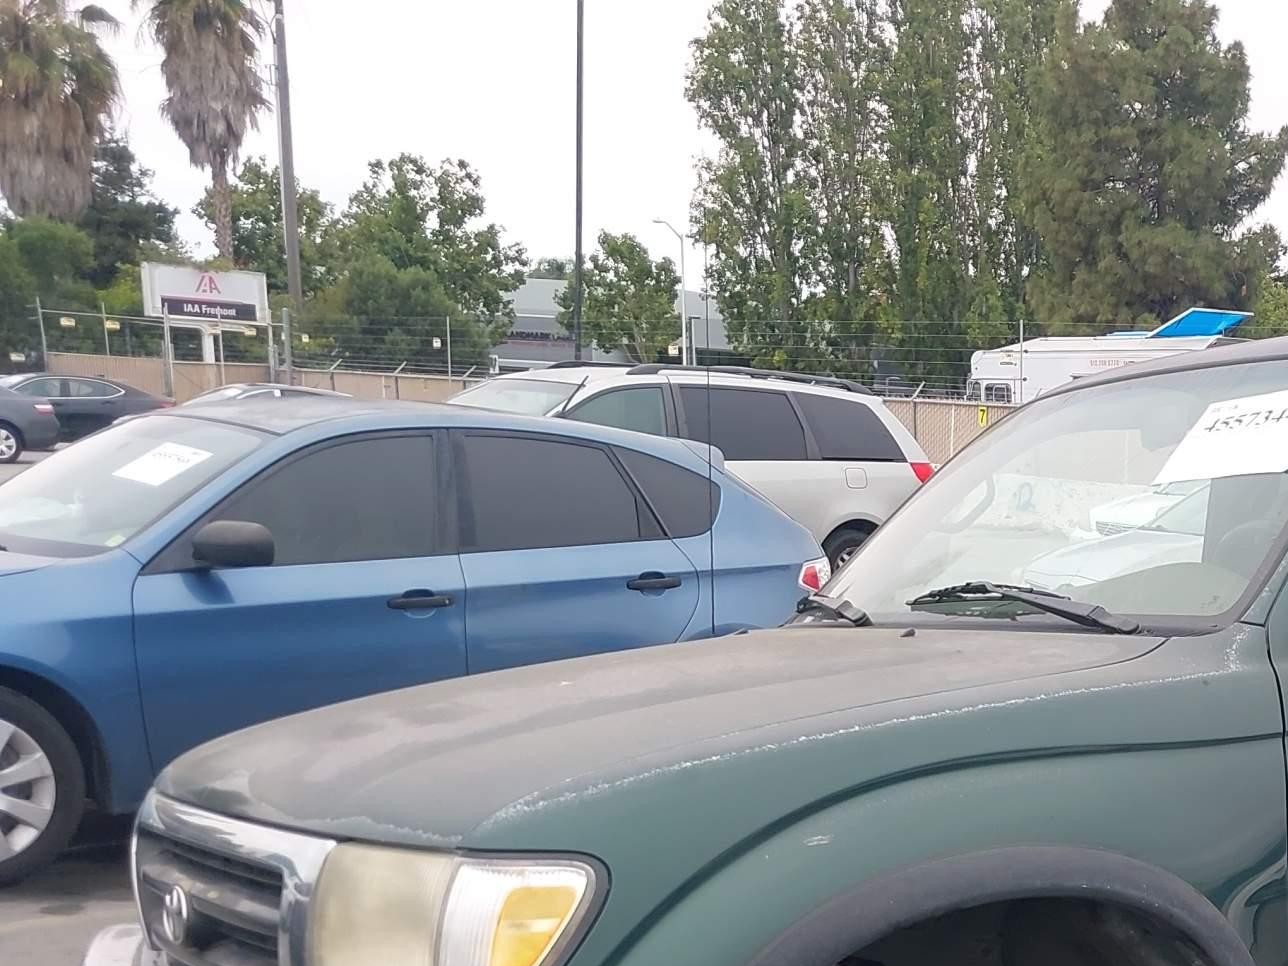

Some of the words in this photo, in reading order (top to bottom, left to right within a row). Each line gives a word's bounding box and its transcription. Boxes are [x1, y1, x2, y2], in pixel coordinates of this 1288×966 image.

[183, 303, 200, 313] IAA
[202, 305, 237, 316] Fremont
[980, 409, 986, 423] 7
